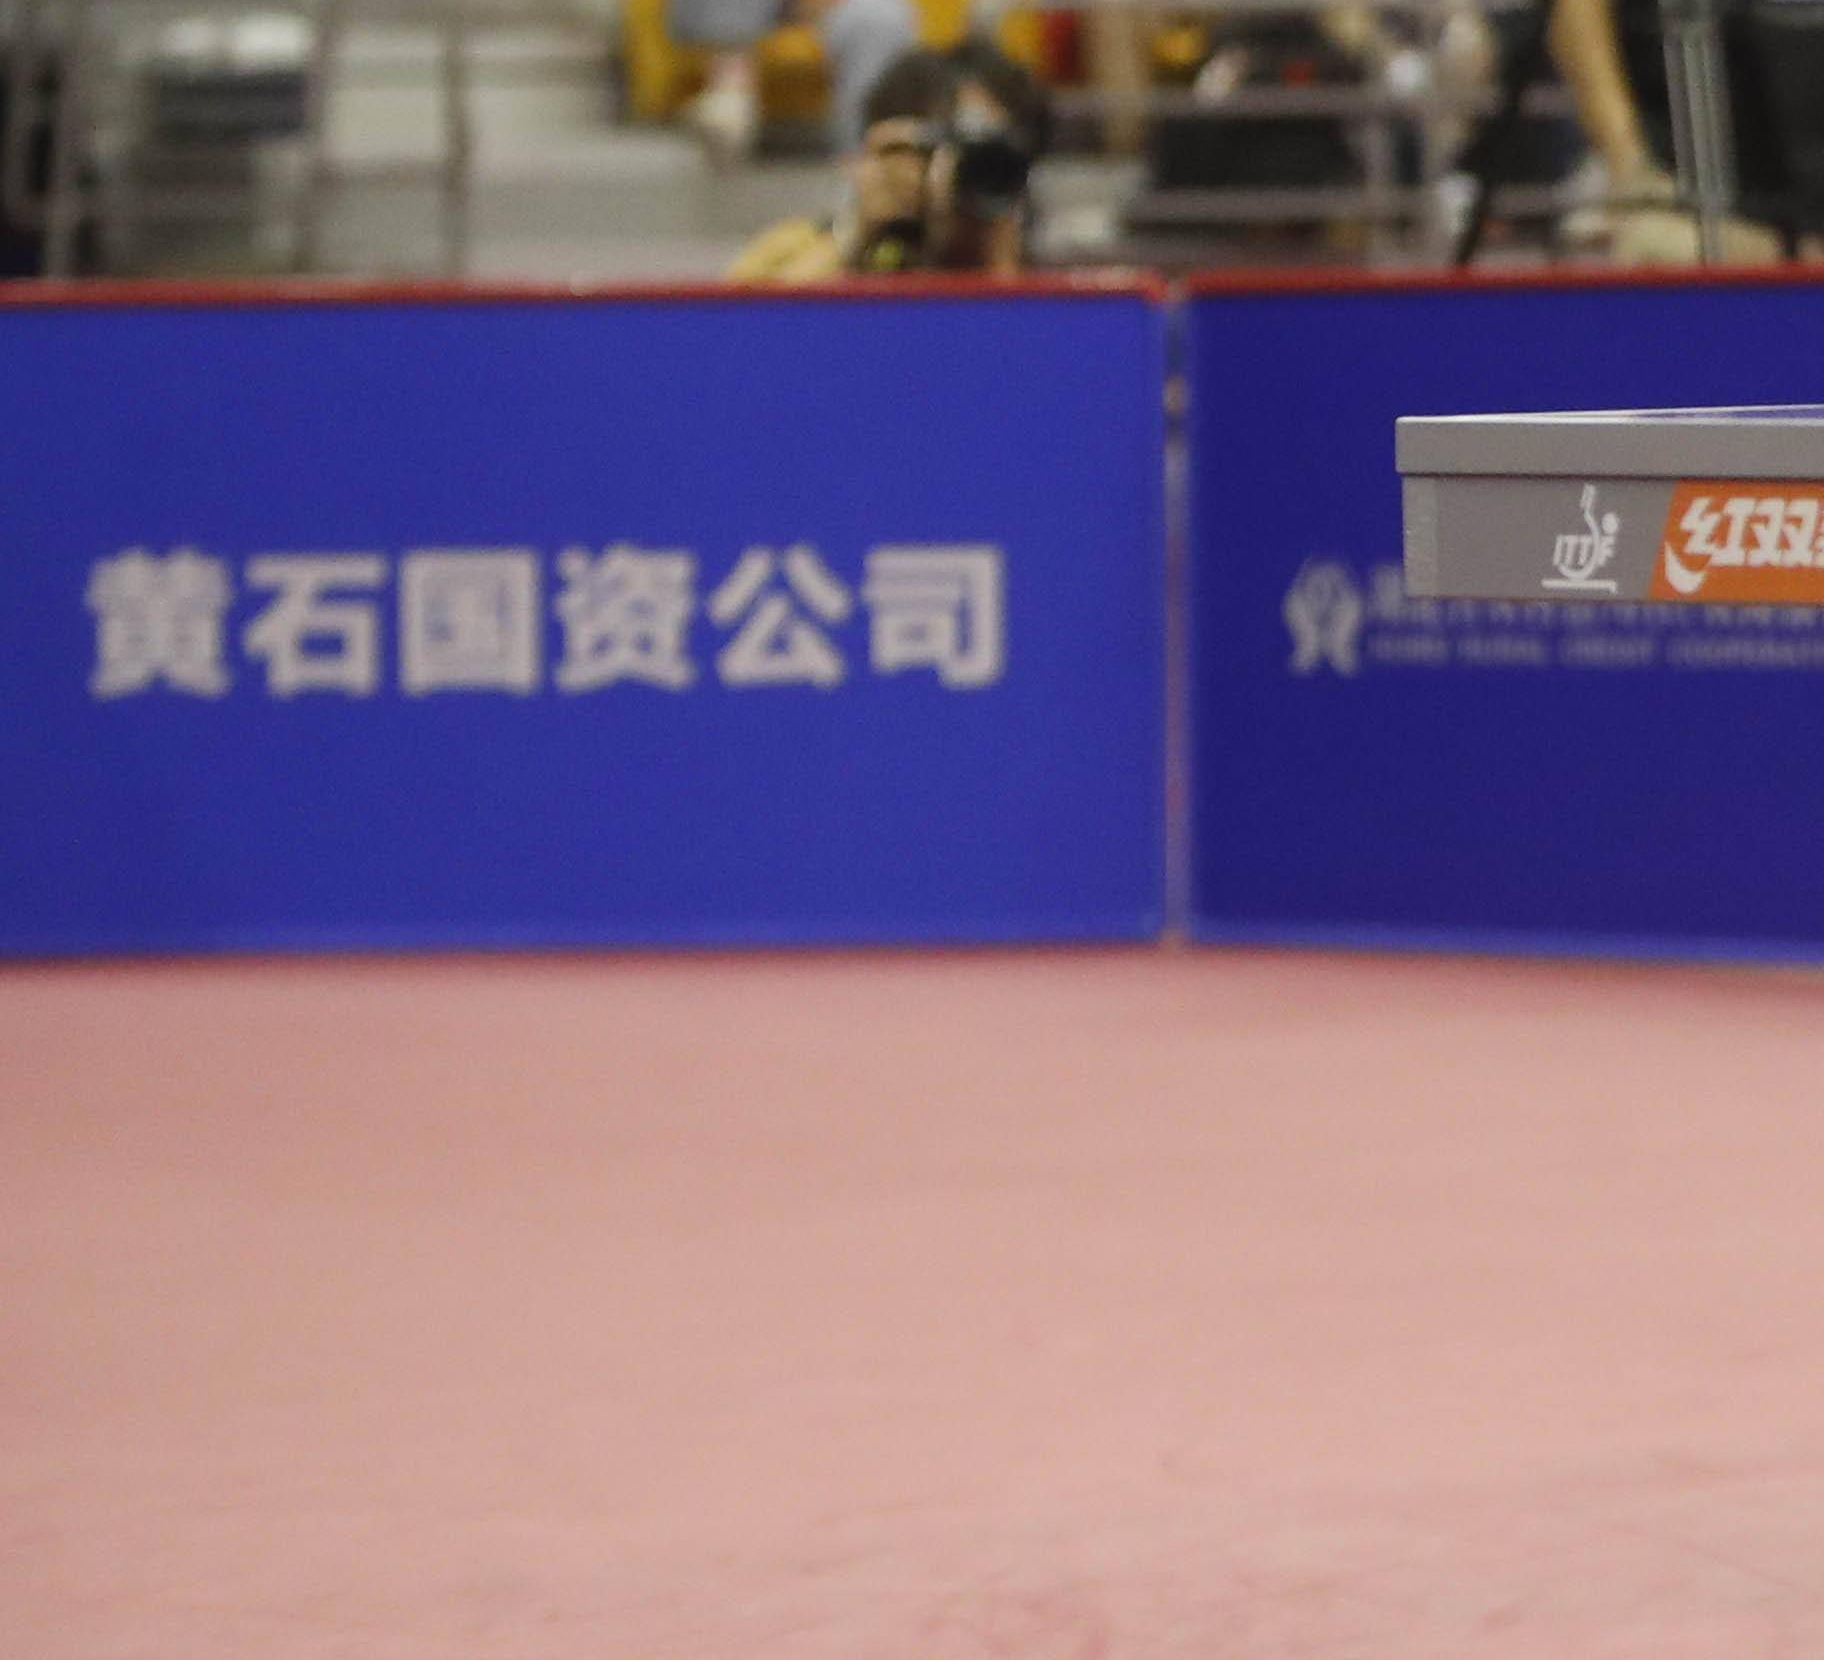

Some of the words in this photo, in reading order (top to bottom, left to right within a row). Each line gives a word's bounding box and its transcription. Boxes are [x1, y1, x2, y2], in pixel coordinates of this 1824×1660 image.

[86, 543, 1006, 697] 黄石国资公司
